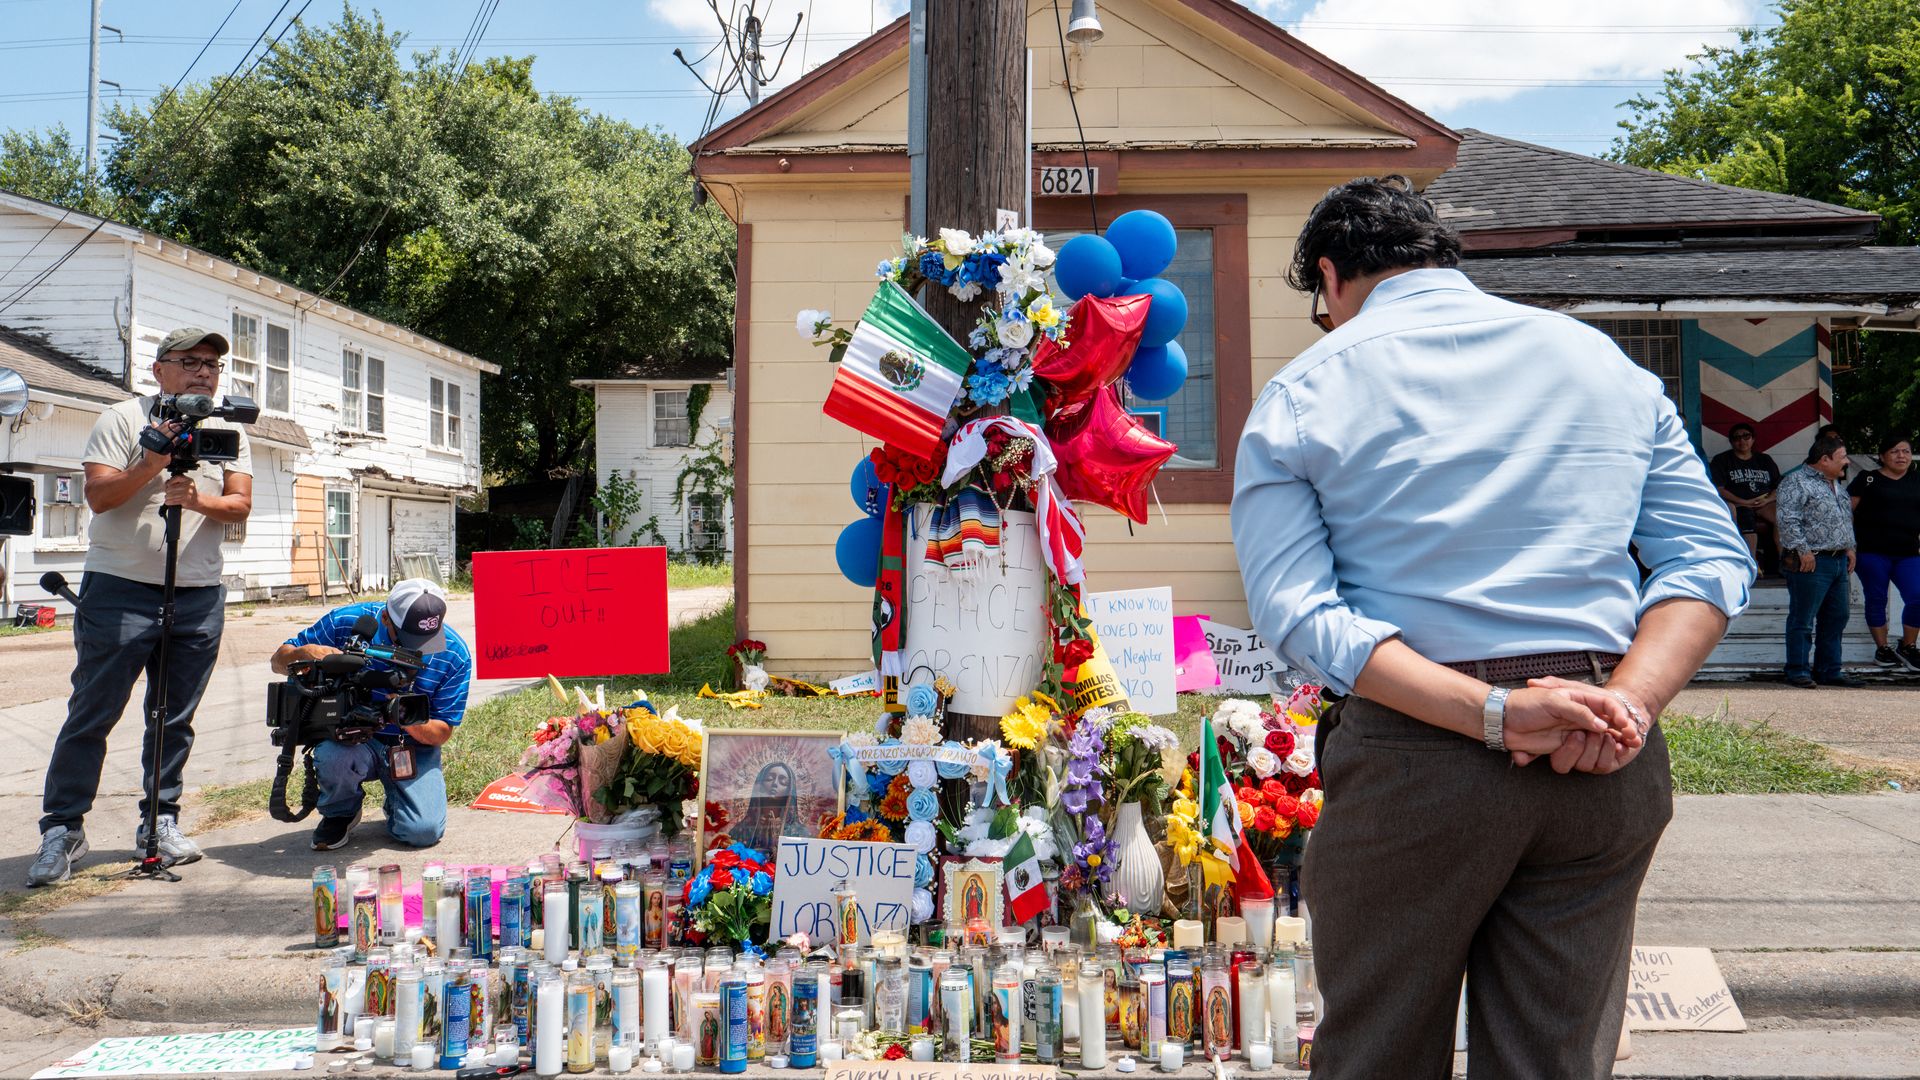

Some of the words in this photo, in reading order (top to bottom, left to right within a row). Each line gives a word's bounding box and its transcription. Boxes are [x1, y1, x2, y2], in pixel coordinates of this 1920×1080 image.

[1042, 168, 1094, 194] 6821
[1729, 470, 1743, 480] SAN
[1744, 469, 1770, 481] JACINTO
[514, 554, 613, 597] ICE
[1108, 597, 1144, 613] KNOW
[1147, 597, 1168, 612] YOU
[1096, 622, 1138, 638] LOVED
[1143, 622, 1164, 636] YOU
[897, 649, 1034, 698] ORENZO
[1217, 658, 1273, 683] illings
[1074, 673, 1113, 695] AMILIAS
[1075, 684, 1119, 711] ANTES!
[856, 747, 897, 760] LORENZO
[782, 842, 915, 878] JUSTICE
[779, 900, 908, 938] LORNZO
[1679, 988, 1729, 1020] Sentence
